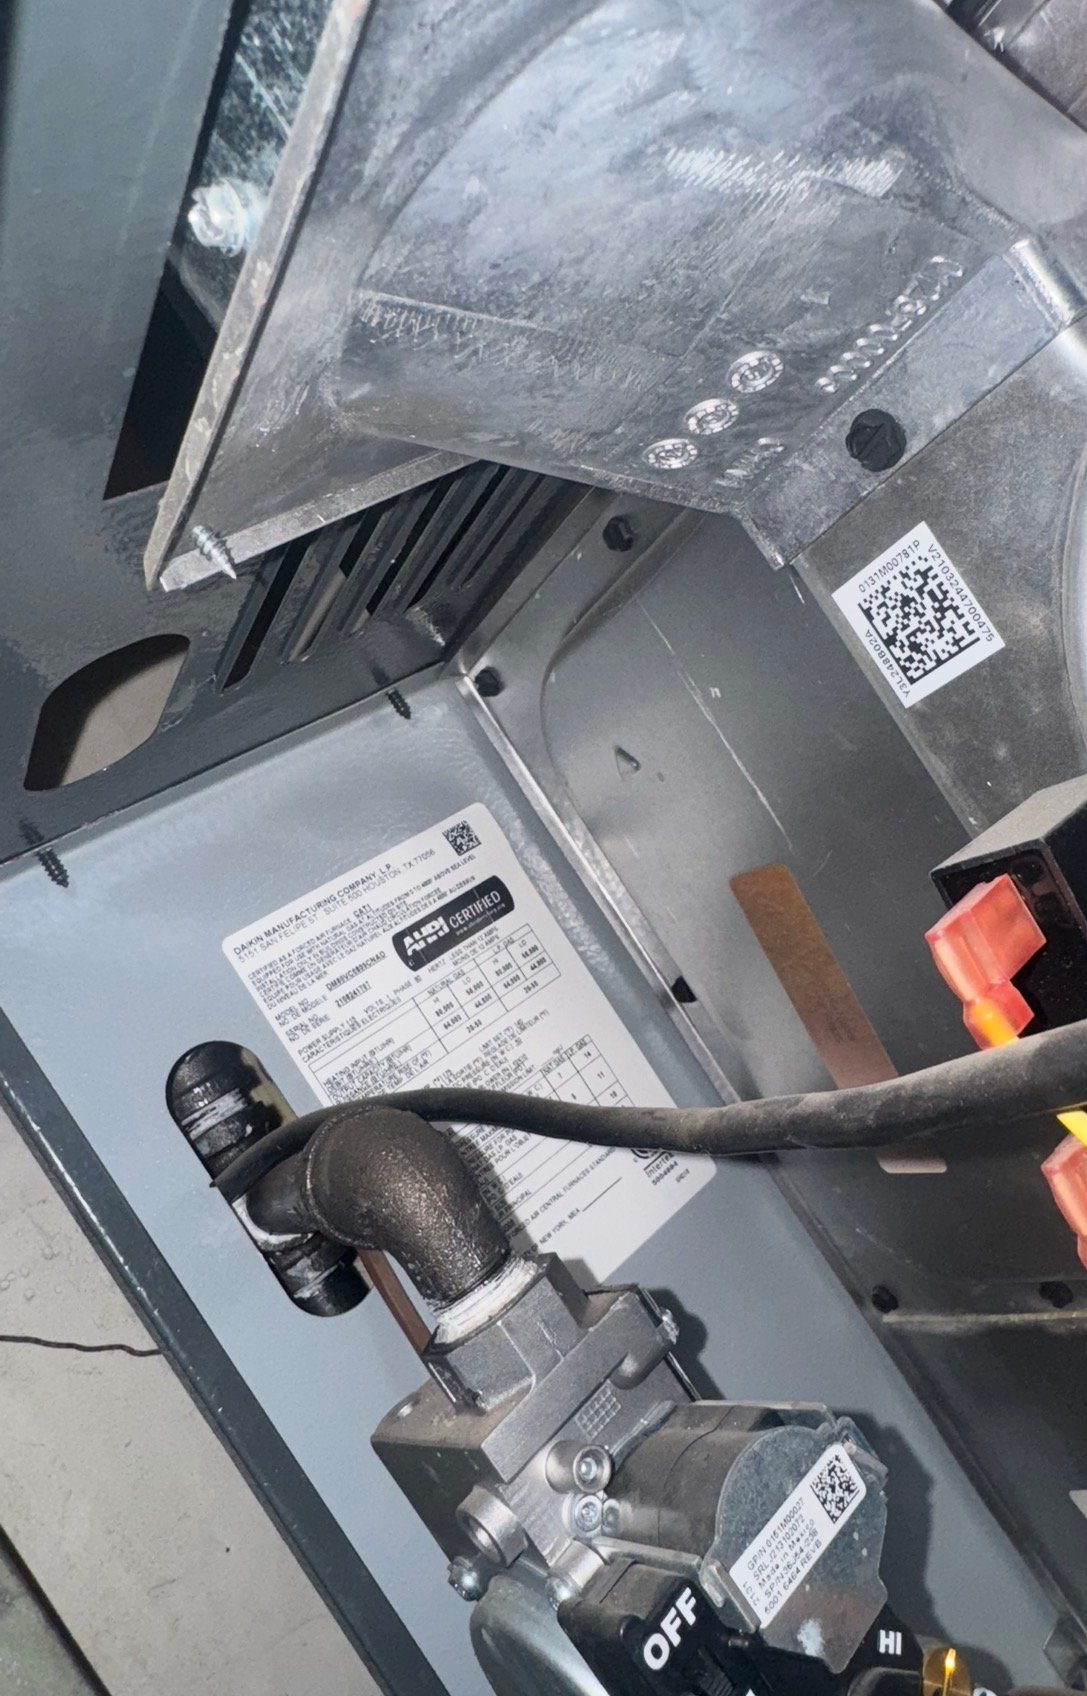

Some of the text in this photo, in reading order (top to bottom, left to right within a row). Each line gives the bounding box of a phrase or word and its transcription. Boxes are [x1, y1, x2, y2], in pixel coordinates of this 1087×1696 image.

[858, 539, 921, 594] 0131M00781P
[927, 543, 995, 643] V2103244700475
[864, 628, 912, 698] Y3L248B02A
[232, 933, 265, 956] DAIKIN
[262, 892, 338, 939] MANUFACTURING
[236, 945, 260, 964] 5151
[258, 934, 279, 952] SAN
[276, 918, 308, 941] FELIPE
[321, 896, 348, 916] SUITE
[346, 887, 363, 902] 500
[401, 858, 415, 871] TX
[412, 846, 436, 865] 77056
[446, 888, 504, 930] CERTIFIED
[399, 915, 451, 957] AHRI
[273, 1003, 298, 1022] MODEL
[751, 1559, 769, 1581] SRL
[757, 1516, 816, 1589] Made in Mexico
[642, 1586, 698, 1670] OFF
[878, 1629, 903, 1656] HI
